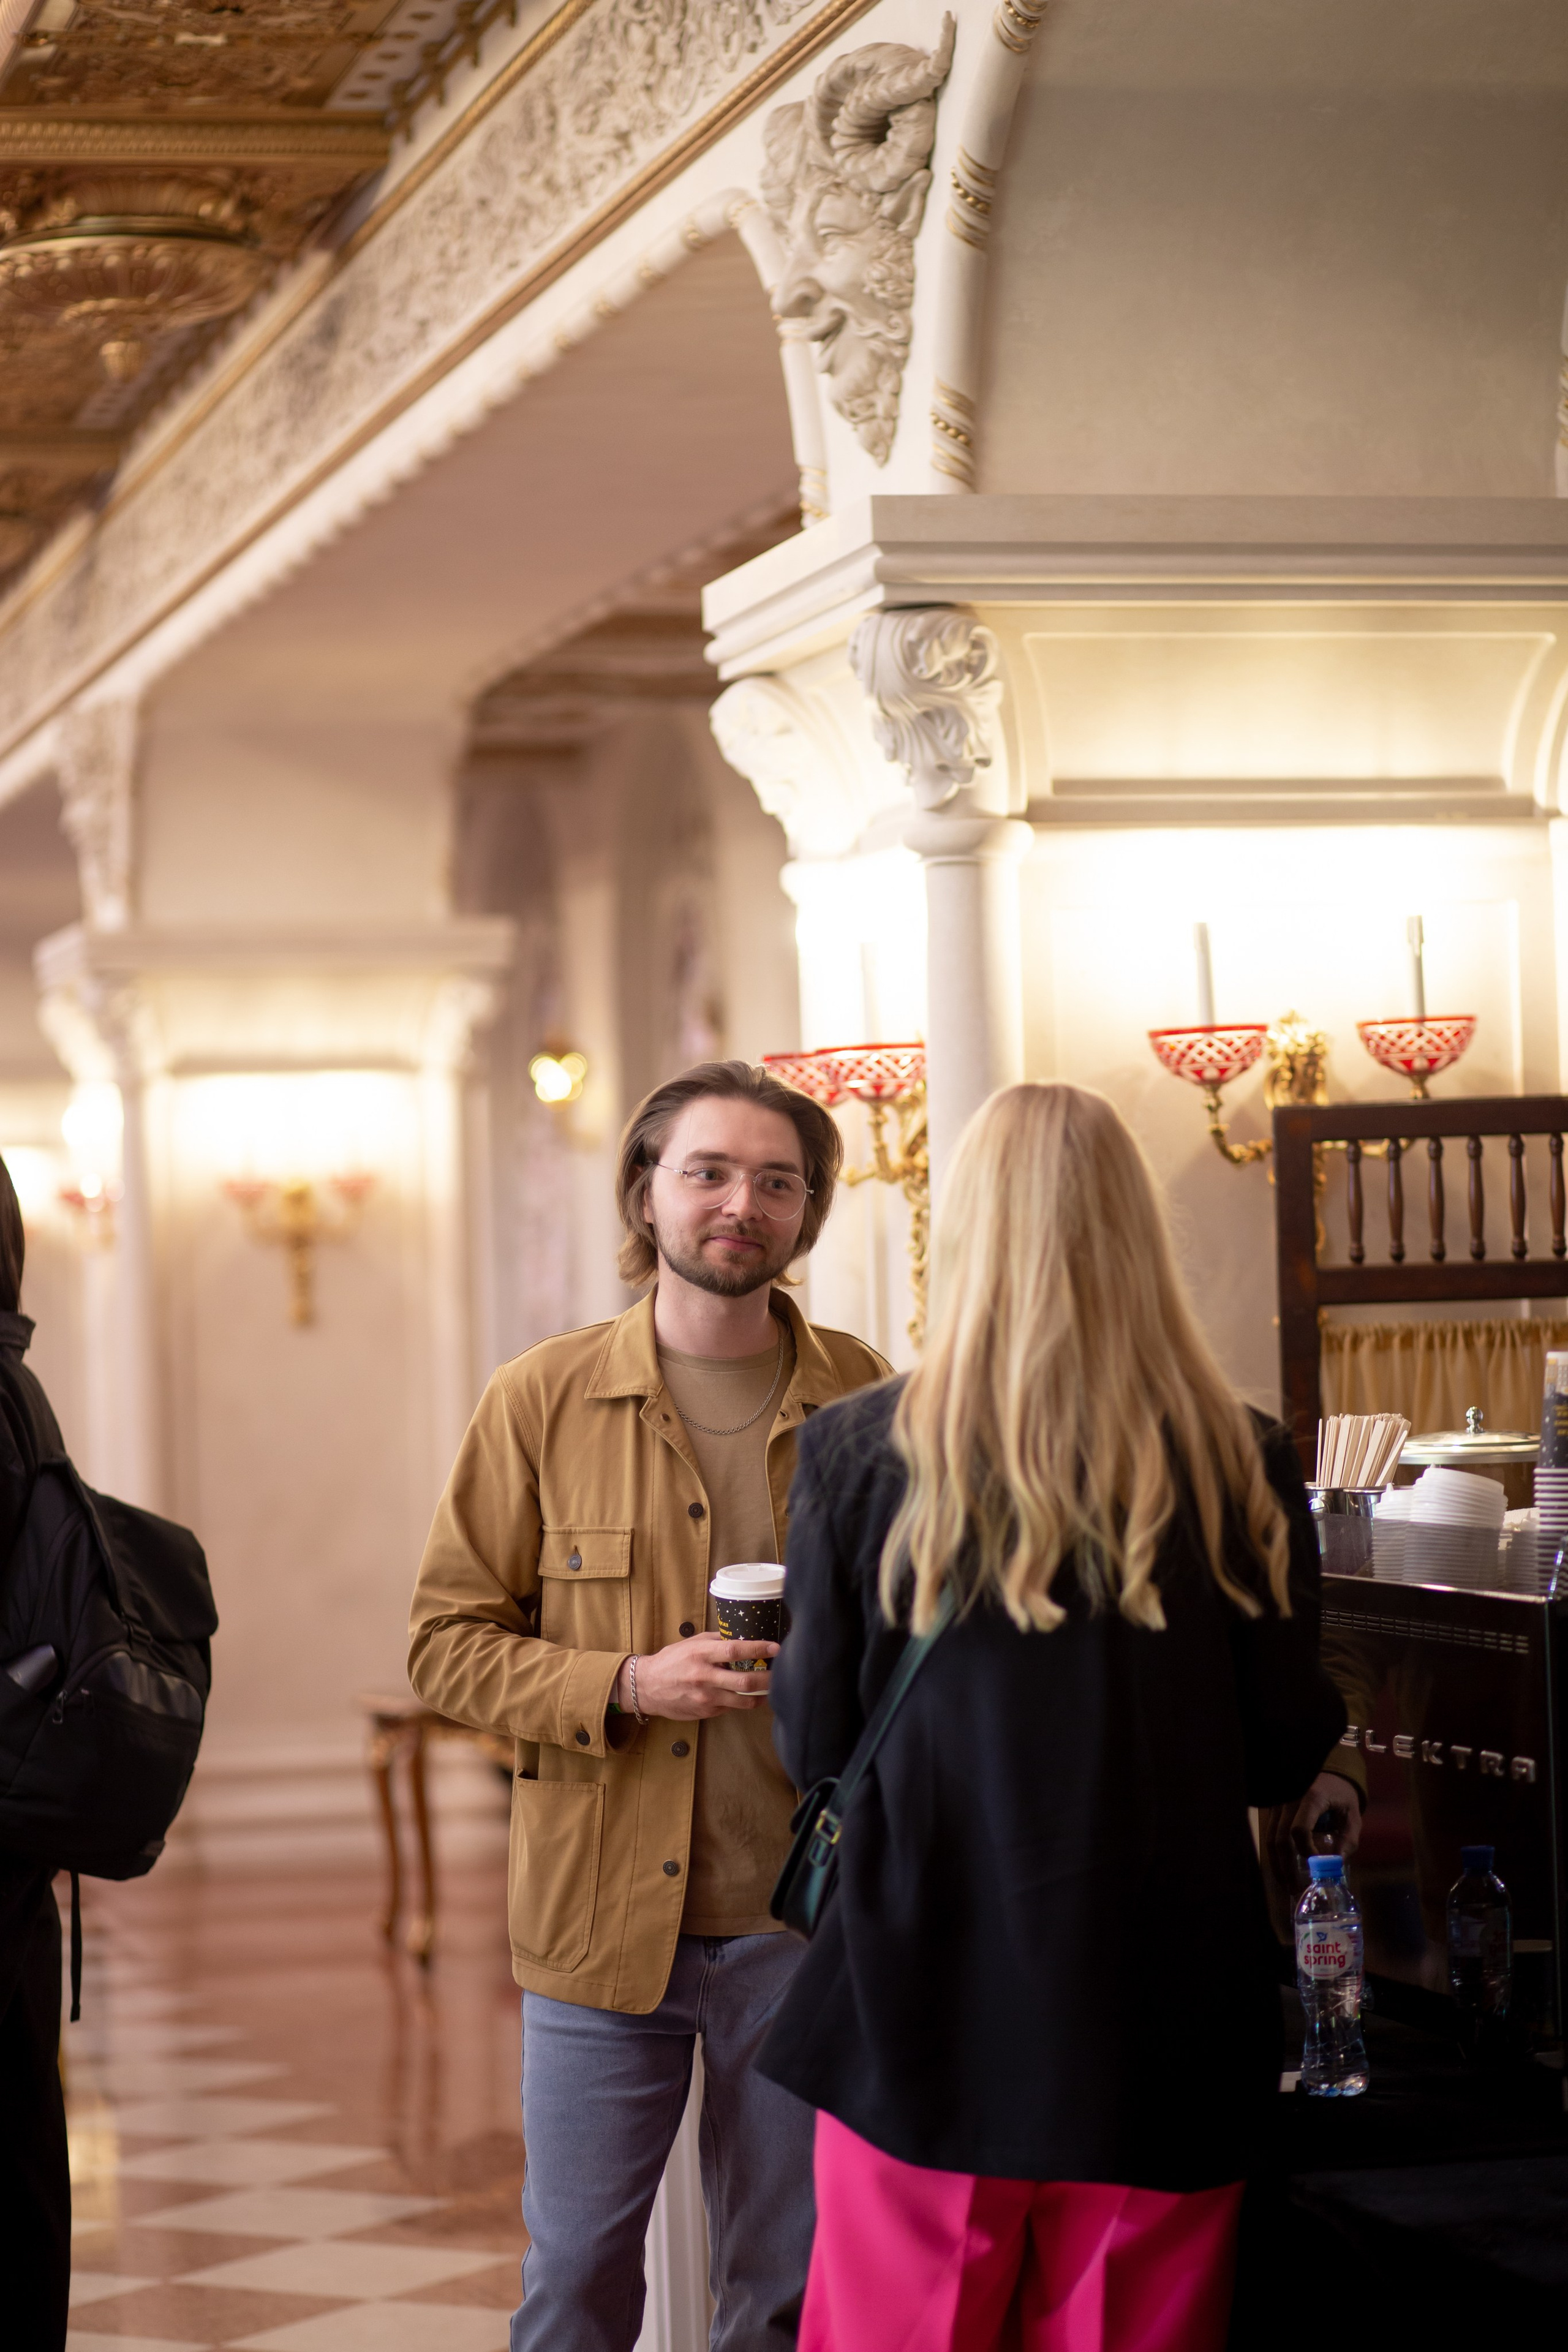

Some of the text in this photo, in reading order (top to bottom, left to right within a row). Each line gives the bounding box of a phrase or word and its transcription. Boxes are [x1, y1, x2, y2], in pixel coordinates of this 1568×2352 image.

[1340, 1725, 1536, 1783] ELEKTRA
[1306, 1942, 1341, 1953] saint
[1304, 1954, 1346, 1968] spring
